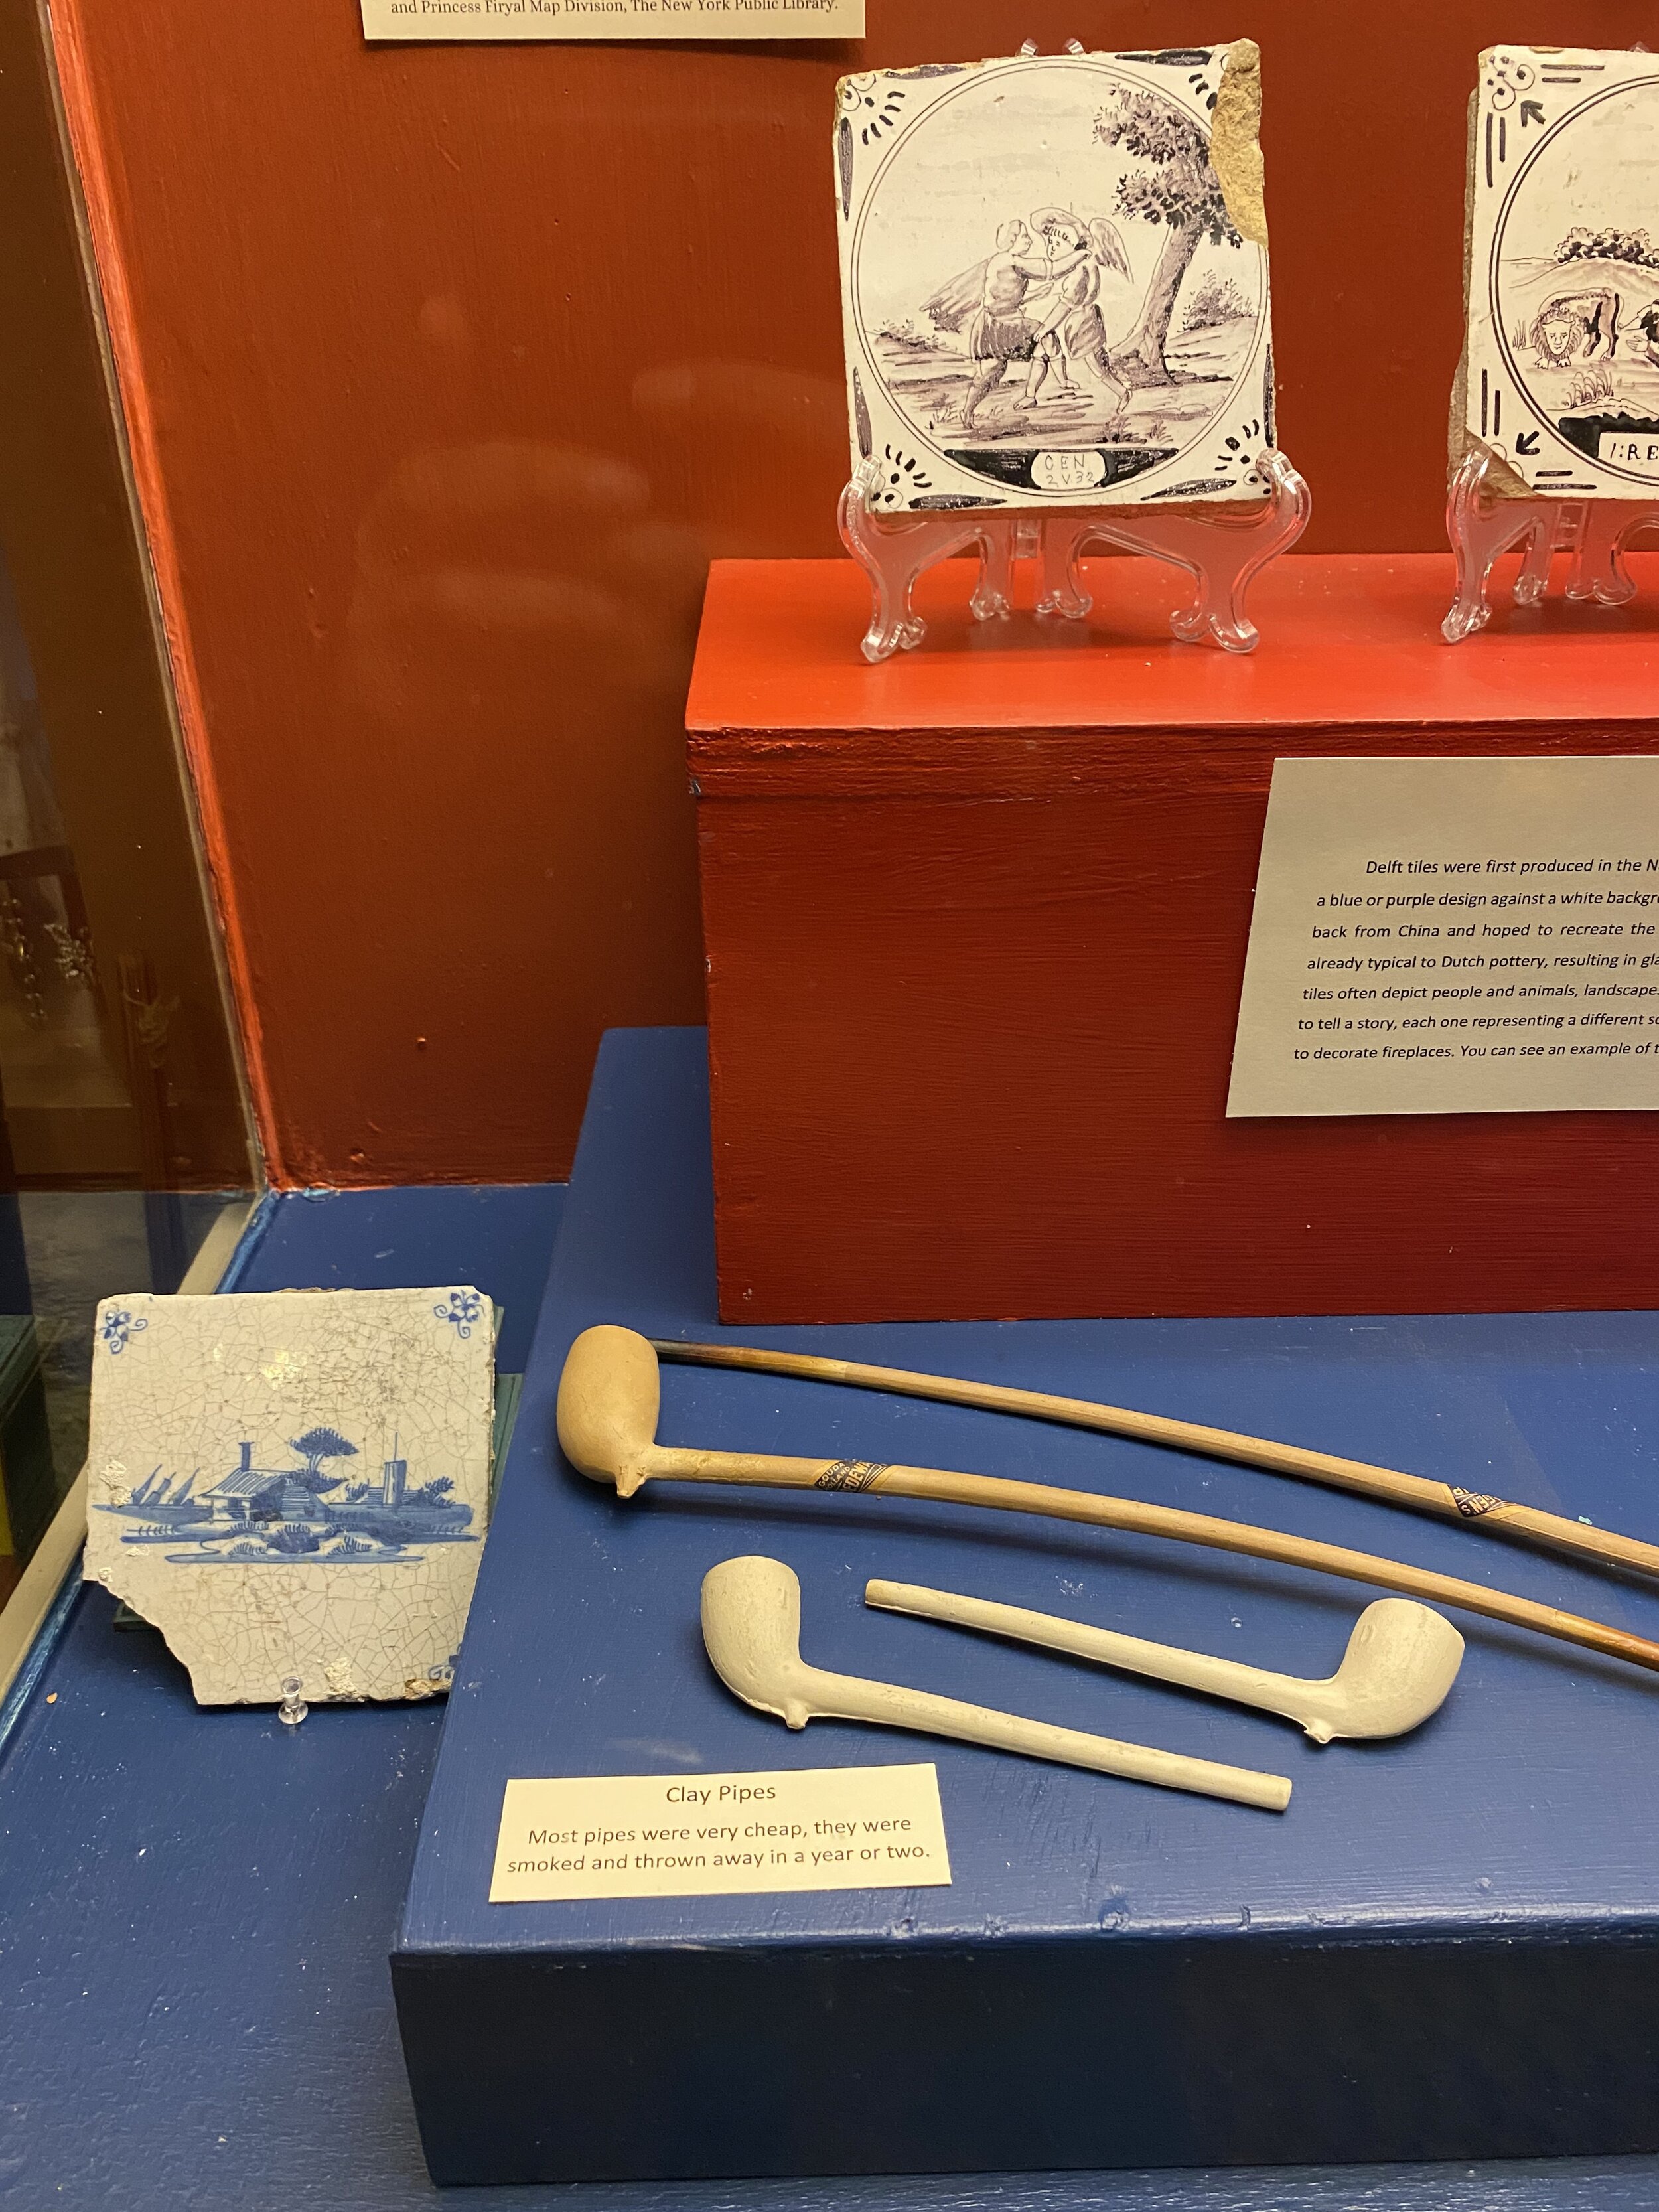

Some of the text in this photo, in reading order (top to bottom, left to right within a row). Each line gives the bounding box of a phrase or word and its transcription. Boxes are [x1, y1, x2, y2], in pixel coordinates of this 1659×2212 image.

[391, 0, 418, 13] and
[421, 0, 481, 13] Princess
[484, 0, 526, 17] Firyal
[529, 0, 560, 17] Map
[564, 0, 627, 14] Division,
[630, 0, 657, 11] The
[662, 0, 693, 11] New
[698, 0, 731, 11] York
[1366, 858, 1659, 875] Delft tiles were first produced in the N
[1317, 891, 1659, 909] a blue or purple design against a white backgr
[1312, 922, 1656, 939] back from China and hoped to recreate the
[1307, 956, 1364, 972] already
[1368, 955, 1417, 972] typical
[1421, 957, 1437, 968] to
[1441, 954, 1484, 968] Dutch
[1488, 956, 1548, 970] pottery,
[1553, 954, 1620, 969] resulting
[1623, 954, 1637, 966] in
[1303, 987, 1334, 1000] tiles
[1337, 987, 1377, 999] often
[1382, 986, 1429, 1001] depict
[1431, 985, 1482, 1001] people
[1486, 984, 1515, 997] and
[1518, 984, 1578, 998] animals,
[1298, 1019, 1314, 1030] to
[1318, 1017, 1341, 1030] tell
[1344, 1020, 1353, 1029] a
[1357, 1018, 1398, 1031] story,
[1402, 1015, 1436, 1029] each
[1440, 1018, 1468, 1028] one
[1472, 1014, 1565, 1030] representing
[1567, 1017, 1576, 1026] a
[1580, 1013, 1645, 1025] different
[1294, 1049, 1309, 1059] to
[1313, 1047, 1378, 1059] decorate
[1382, 1045, 1455, 1061] fireplaces.
[1461, 1045, 1486, 1057] You
[1490, 1047, 1516, 1056] can
[1519, 1046, 1544, 1056] see
[1548, 1046, 1565, 1055] an
[1570, 1042, 1631, 1057] example
[1634, 1041, 1652, 1054] of
[818, 1462, 846, 1487] GOUDA
[826, 1465, 851, 1490] OLLAND
[666, 1784, 776, 1806] Clay Pipes
[528, 1819, 912, 1846] Most pipes were very cheap, they were
[506, 1845, 930, 1873] smoked and thrown away in a year or two.
